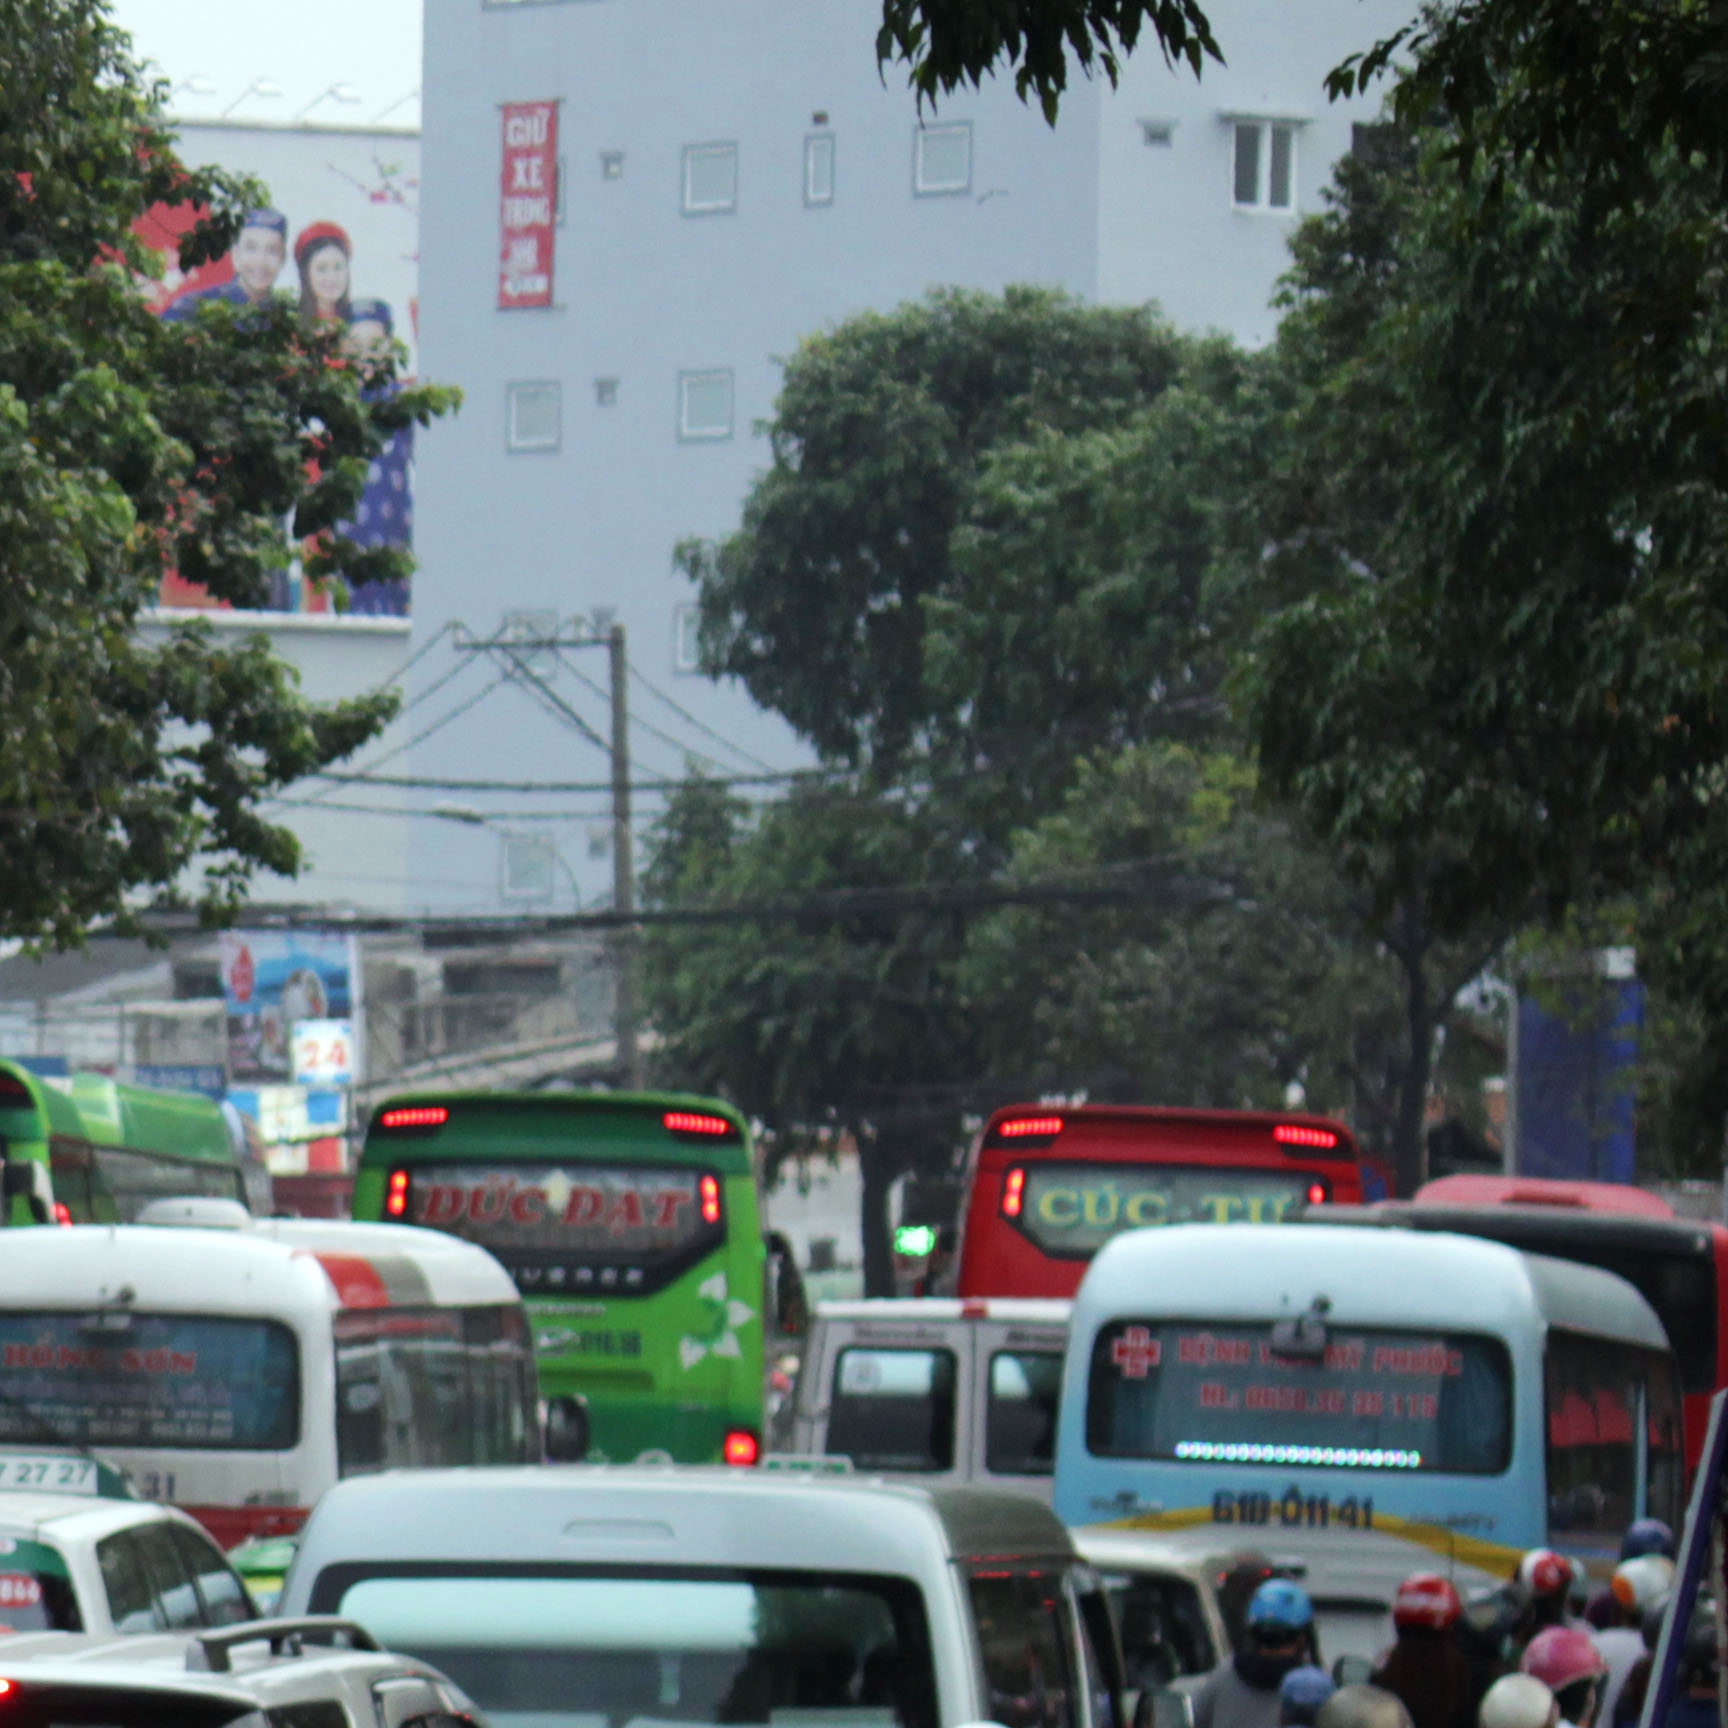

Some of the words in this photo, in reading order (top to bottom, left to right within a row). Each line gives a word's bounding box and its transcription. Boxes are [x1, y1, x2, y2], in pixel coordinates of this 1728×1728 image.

[513, 157, 543, 190] XE
[16, 1462, 49, 1484] 27
[58, 1462, 91, 1485] 27
